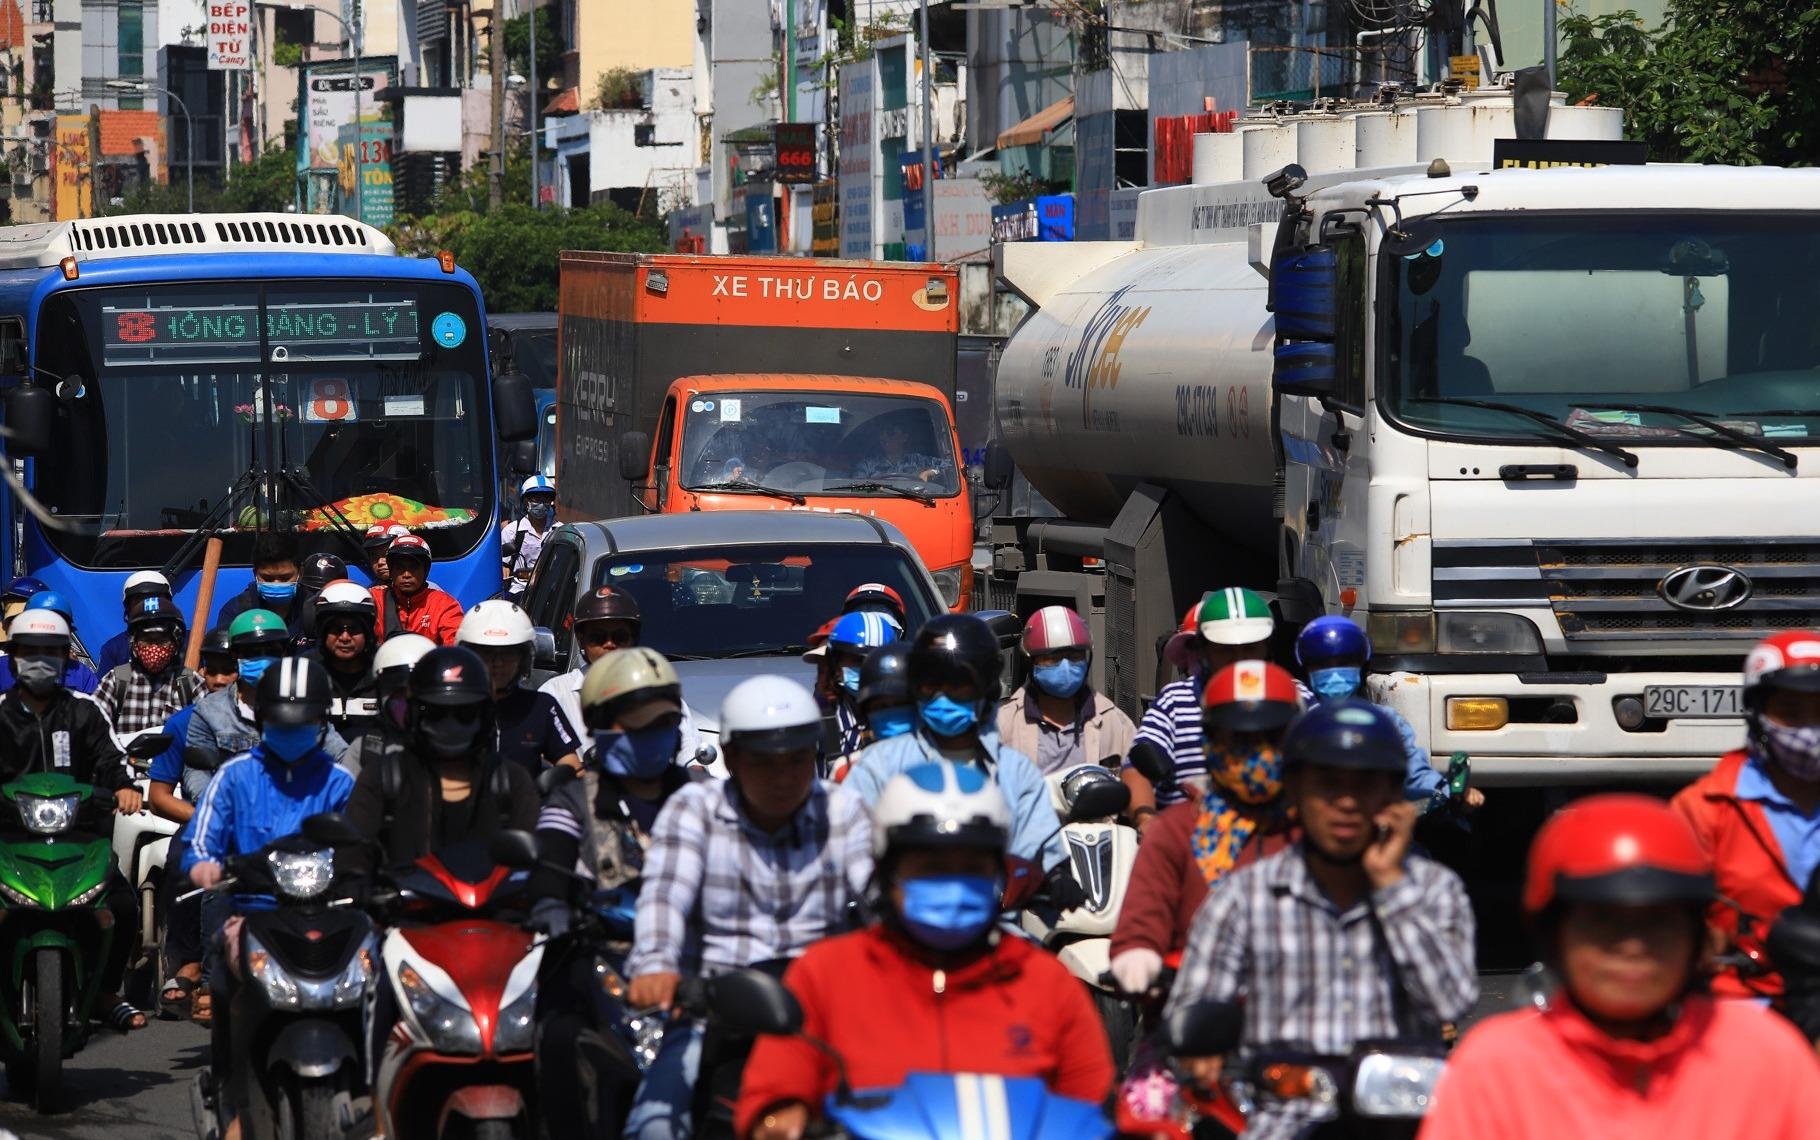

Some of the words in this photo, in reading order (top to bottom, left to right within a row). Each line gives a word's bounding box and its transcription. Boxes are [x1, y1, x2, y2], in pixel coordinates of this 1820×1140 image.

[211, 2, 247, 17] BẾP
[211, 20, 248, 36] ĐIỆN
[779, 151, 812, 166] 666
[712, 275, 748, 297] XE
[757, 275, 816, 299] THƯ
[823, 274, 882, 301] BÁO
[117, 311, 157, 342] 8
[364, 306, 399, 335] LÝ
[314, 380, 349, 420] 8
[1649, 688, 1745, 714] 29C-171.
